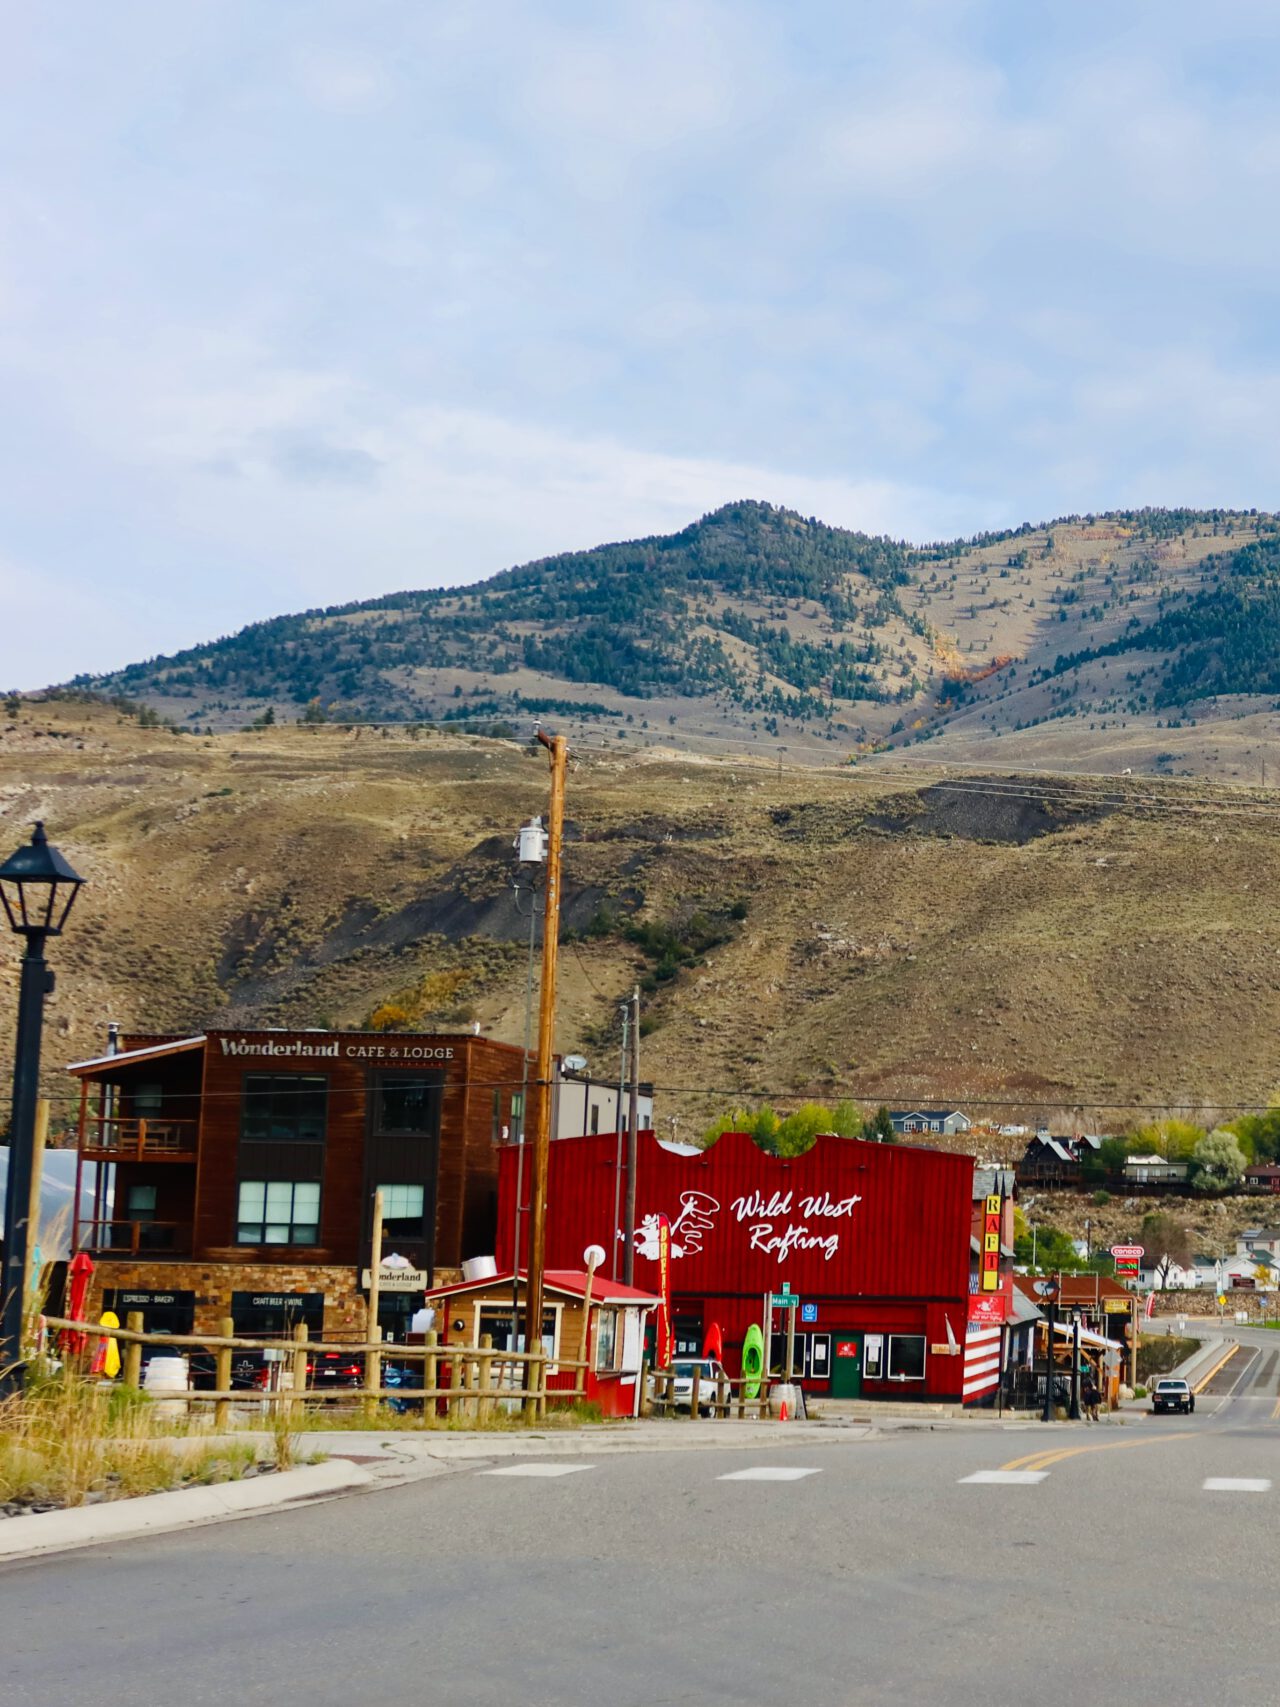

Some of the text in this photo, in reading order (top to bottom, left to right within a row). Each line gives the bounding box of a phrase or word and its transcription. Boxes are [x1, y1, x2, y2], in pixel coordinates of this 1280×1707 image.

[219, 1038, 454, 1059] Wonderland CAFE & LODGE
[730, 1189, 862, 1222] Wild West
[748, 1223, 839, 1264] Rafting
[986, 1199, 998, 1269] RAFT
[378, 1271, 422, 1282] nderland
